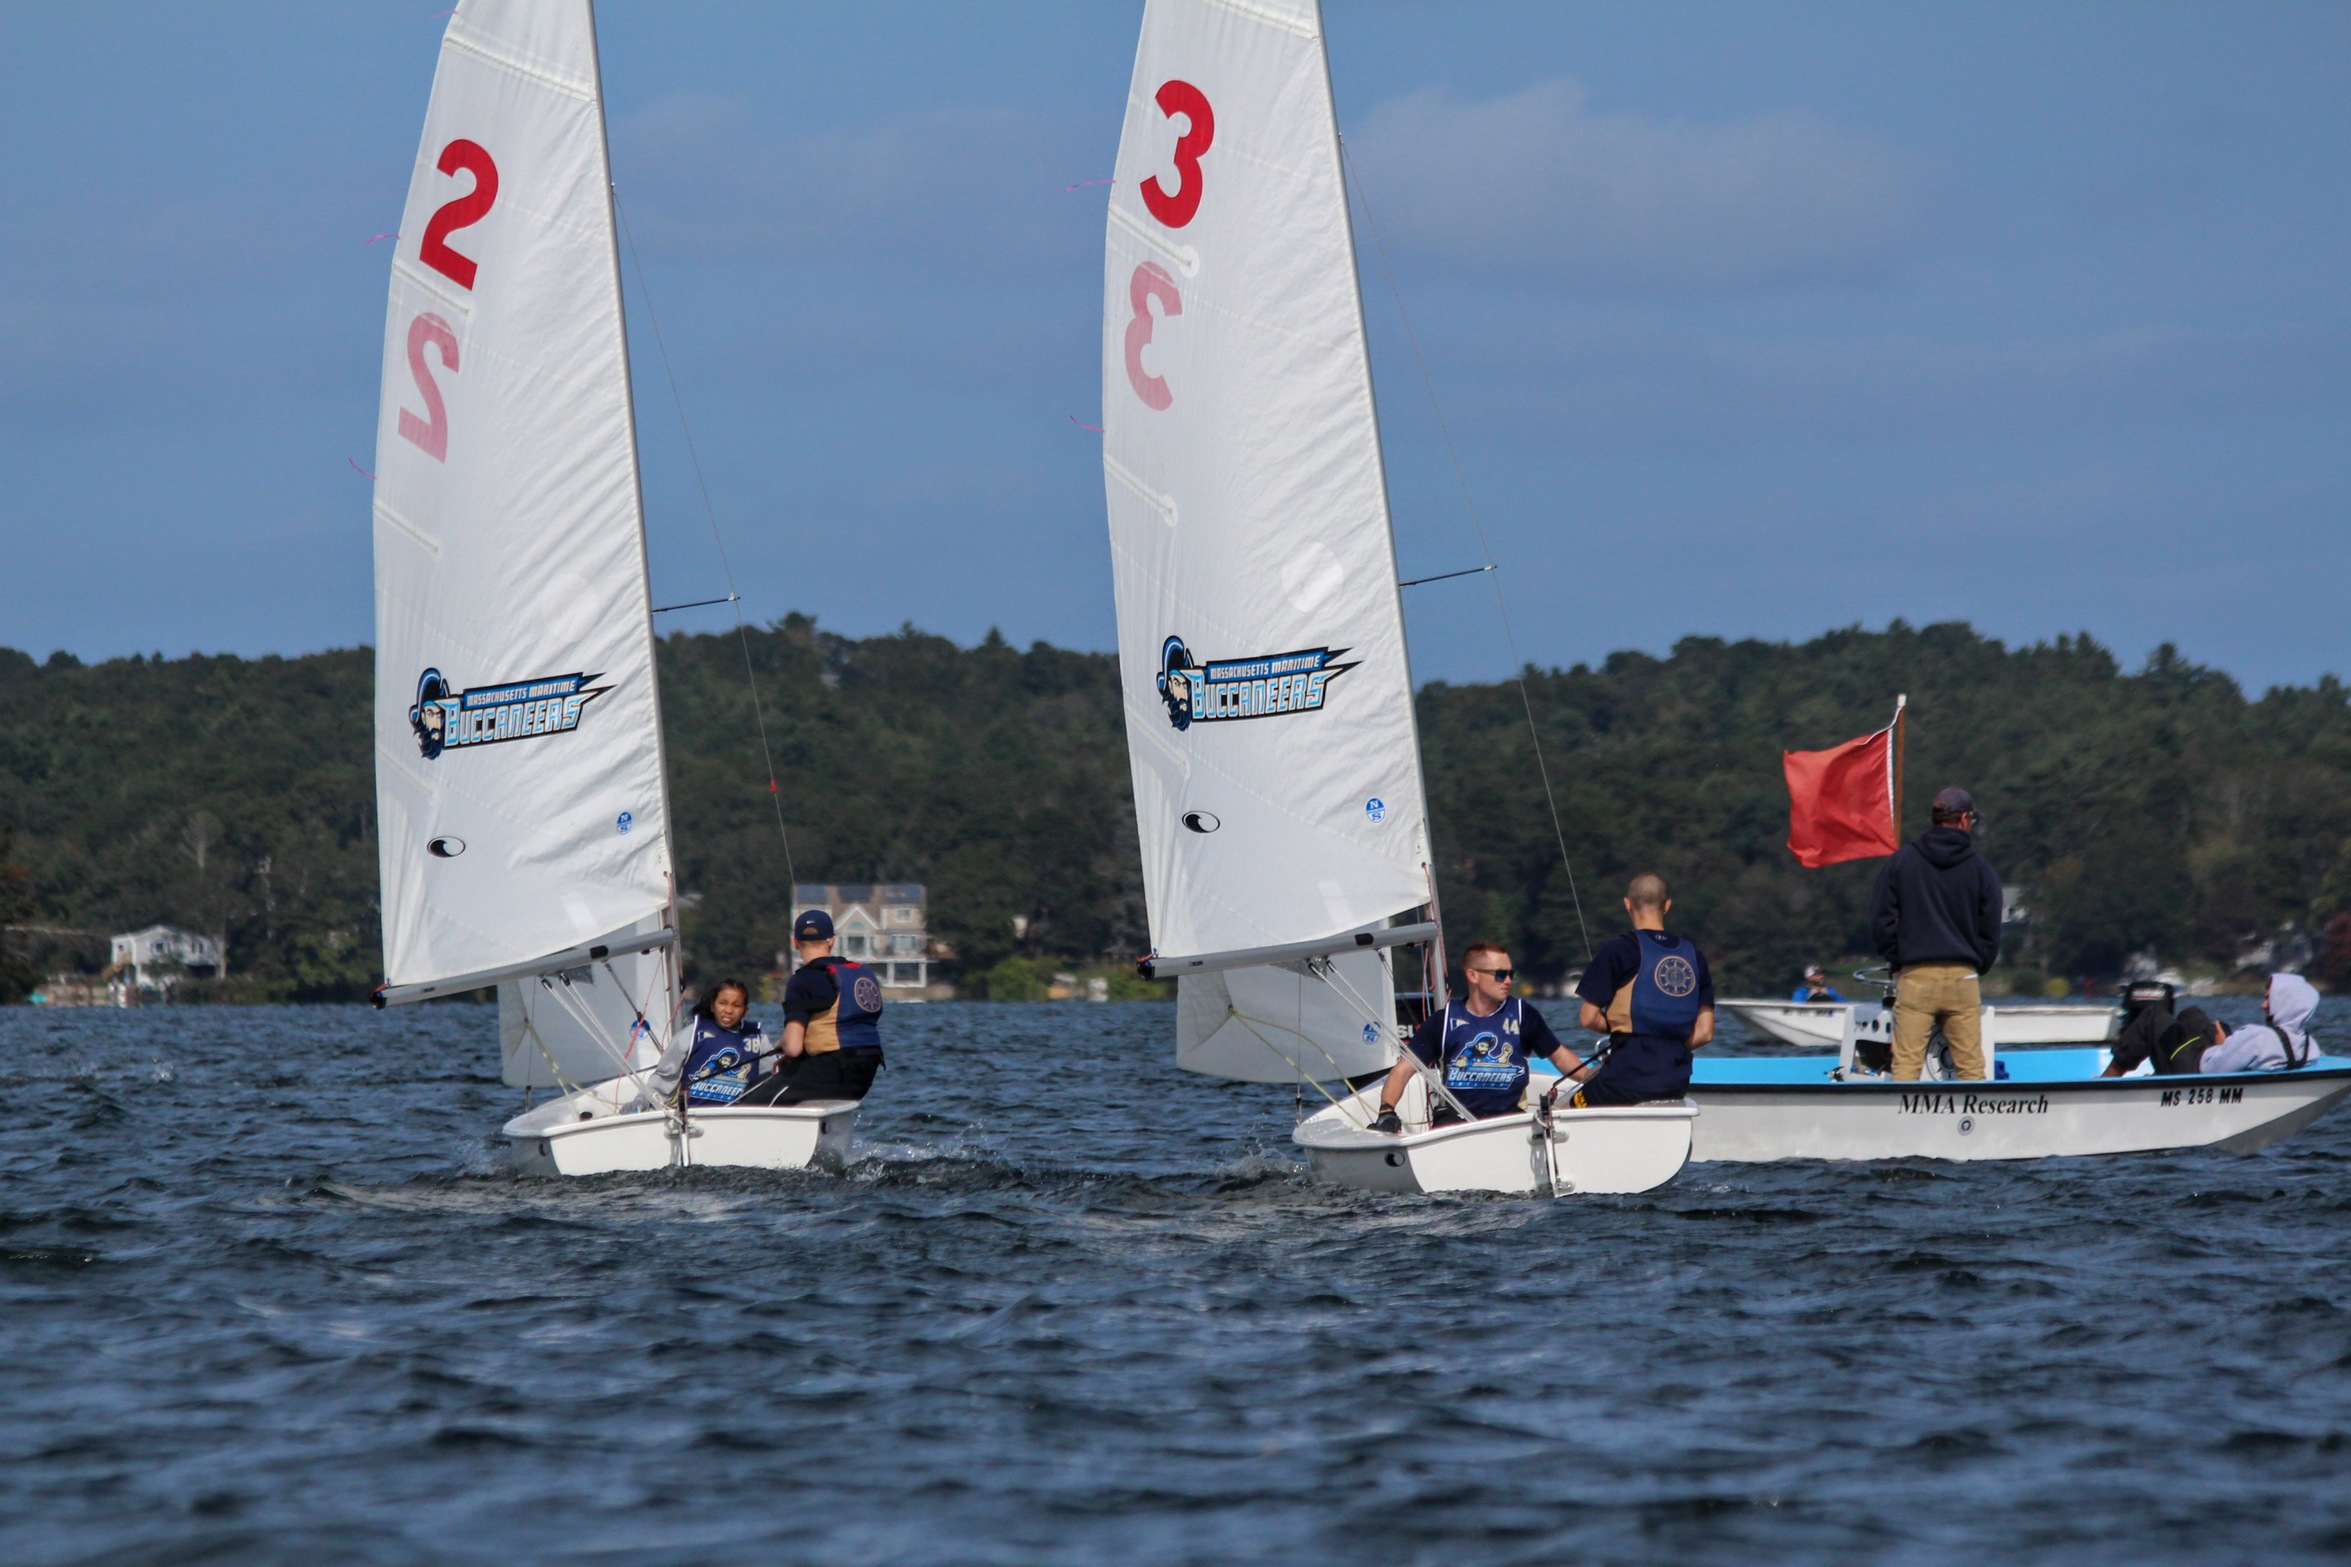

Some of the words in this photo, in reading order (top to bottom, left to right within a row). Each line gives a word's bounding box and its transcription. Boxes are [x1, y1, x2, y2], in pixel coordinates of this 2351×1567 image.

[1140, 79, 1215, 229] 3
[419, 138, 499, 292] 2
[1210, 662, 1269, 680] MASSACHUSETTS
[1271, 655, 1320, 674] MARITIME
[466, 687, 528, 707] MASSACHUSETTS
[529, 680, 576, 698] MARITIME
[1180, 668, 1343, 719] BUCCANEERS
[436, 692, 599, 746] BUCCANEERS
[1502, 1018, 1520, 1035] 44
[1898, 1094, 1955, 1114] MMA
[1962, 1094, 2048, 1114] Research
[2160, 1091, 2181, 1107] MS
[2188, 1087, 2214, 1105] 258
[2218, 1087, 2244, 1104] MM
